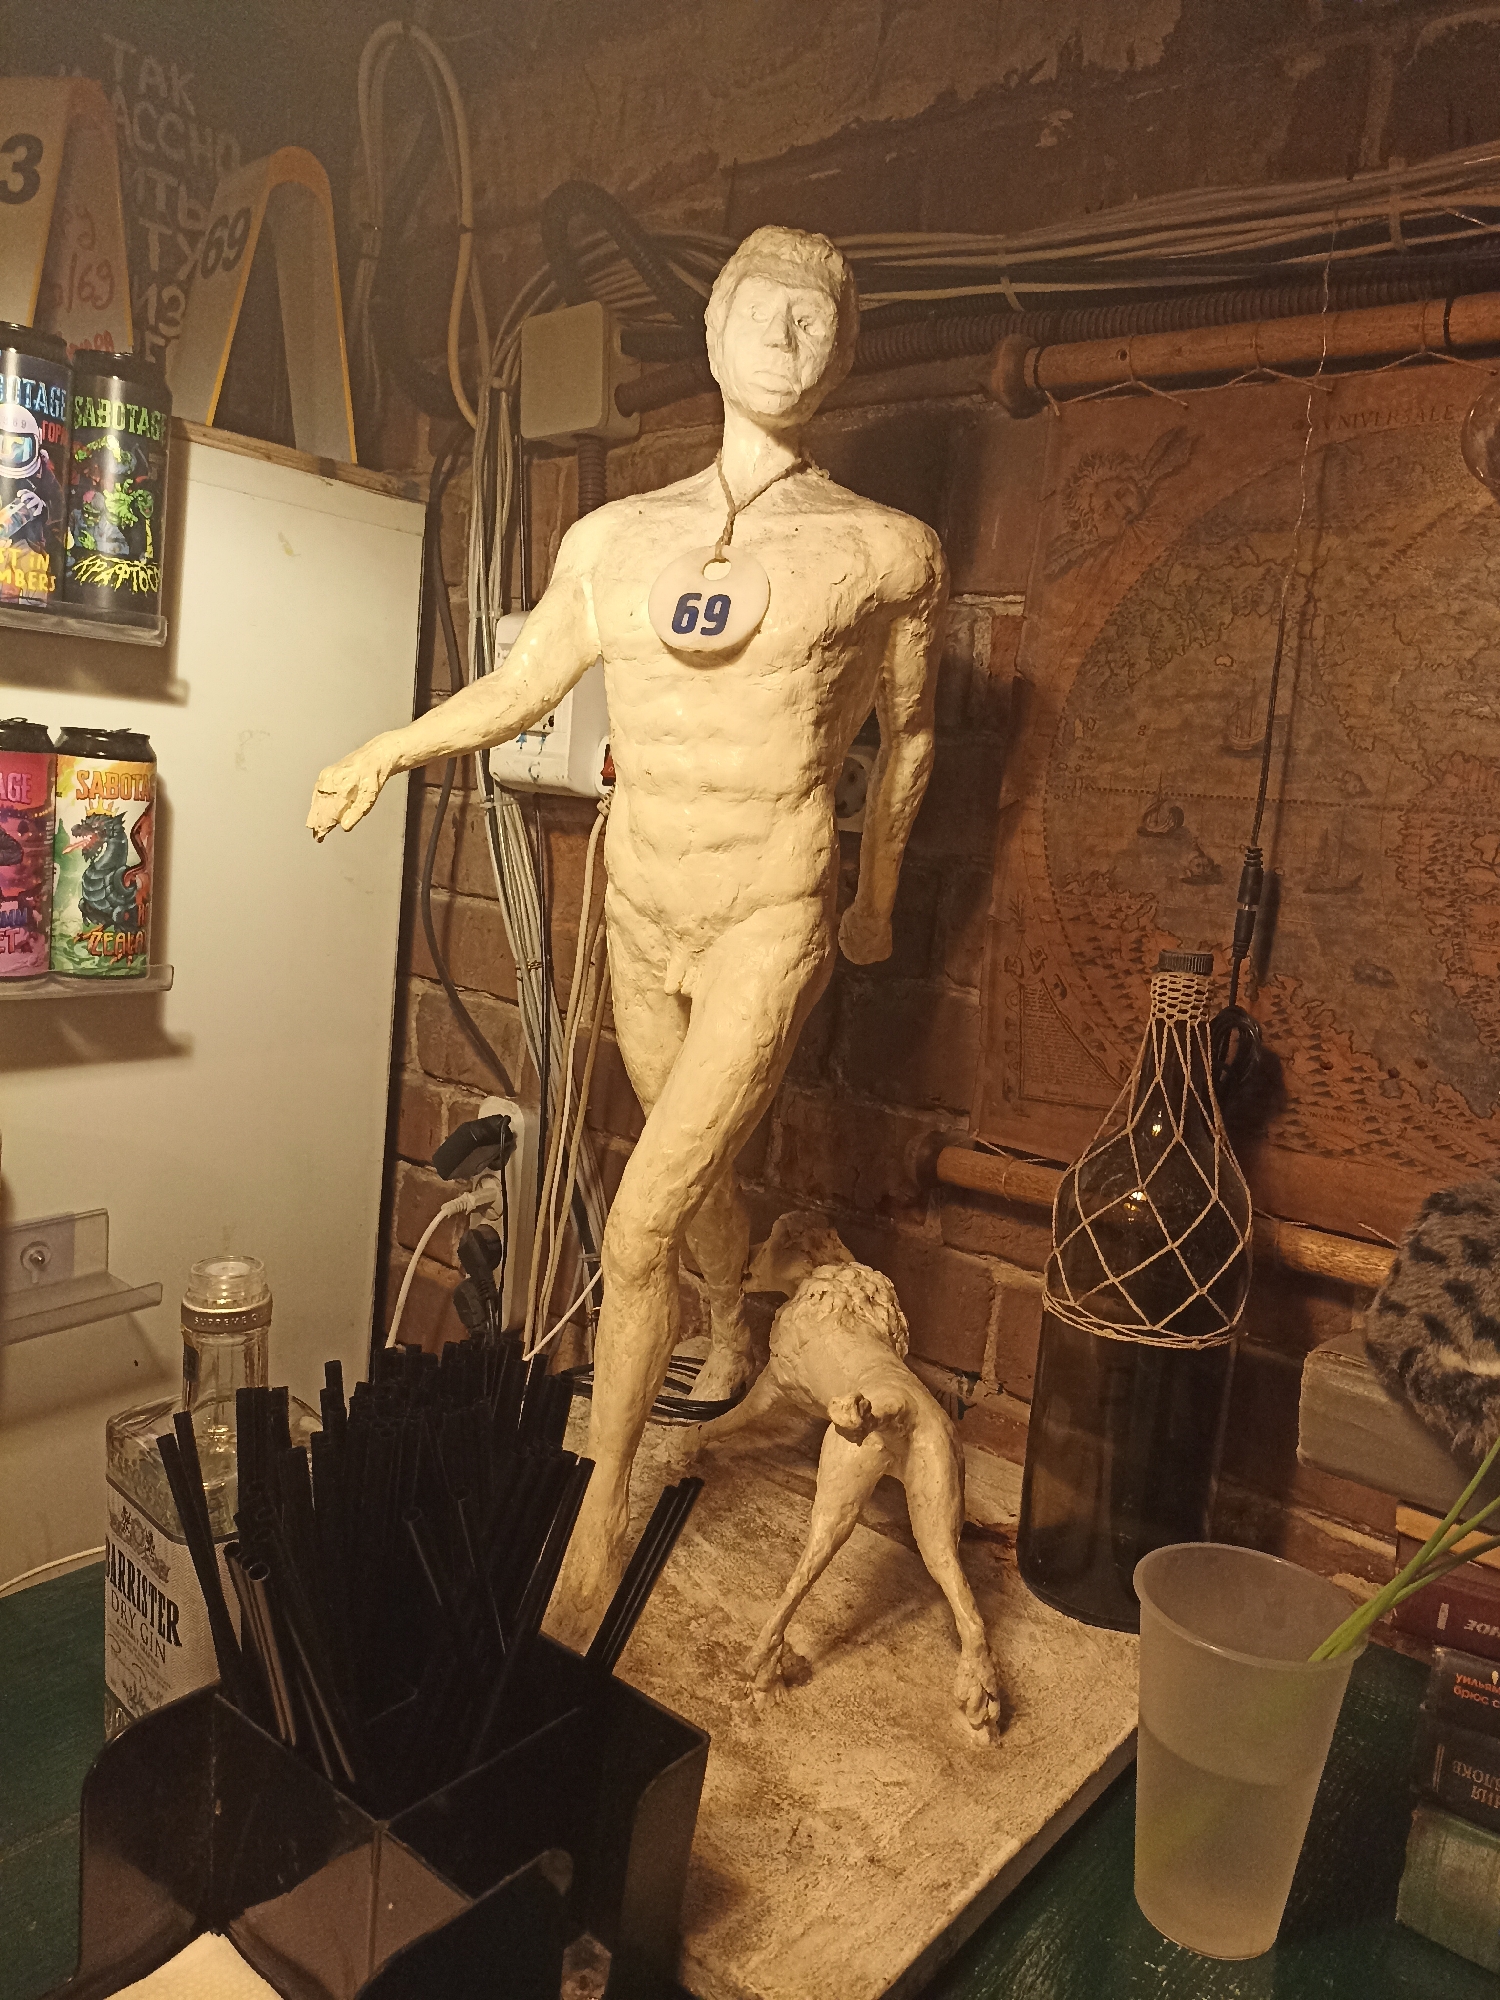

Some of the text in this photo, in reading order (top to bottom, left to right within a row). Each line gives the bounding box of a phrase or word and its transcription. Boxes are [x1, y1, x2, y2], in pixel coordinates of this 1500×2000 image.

[103, 33, 195, 115] ТАК
[200, 207, 252, 279] 69
[671, 592, 732, 636] 69
[111, 1588, 137, 1630] DRY
[140, 1622, 166, 1664] GIN
